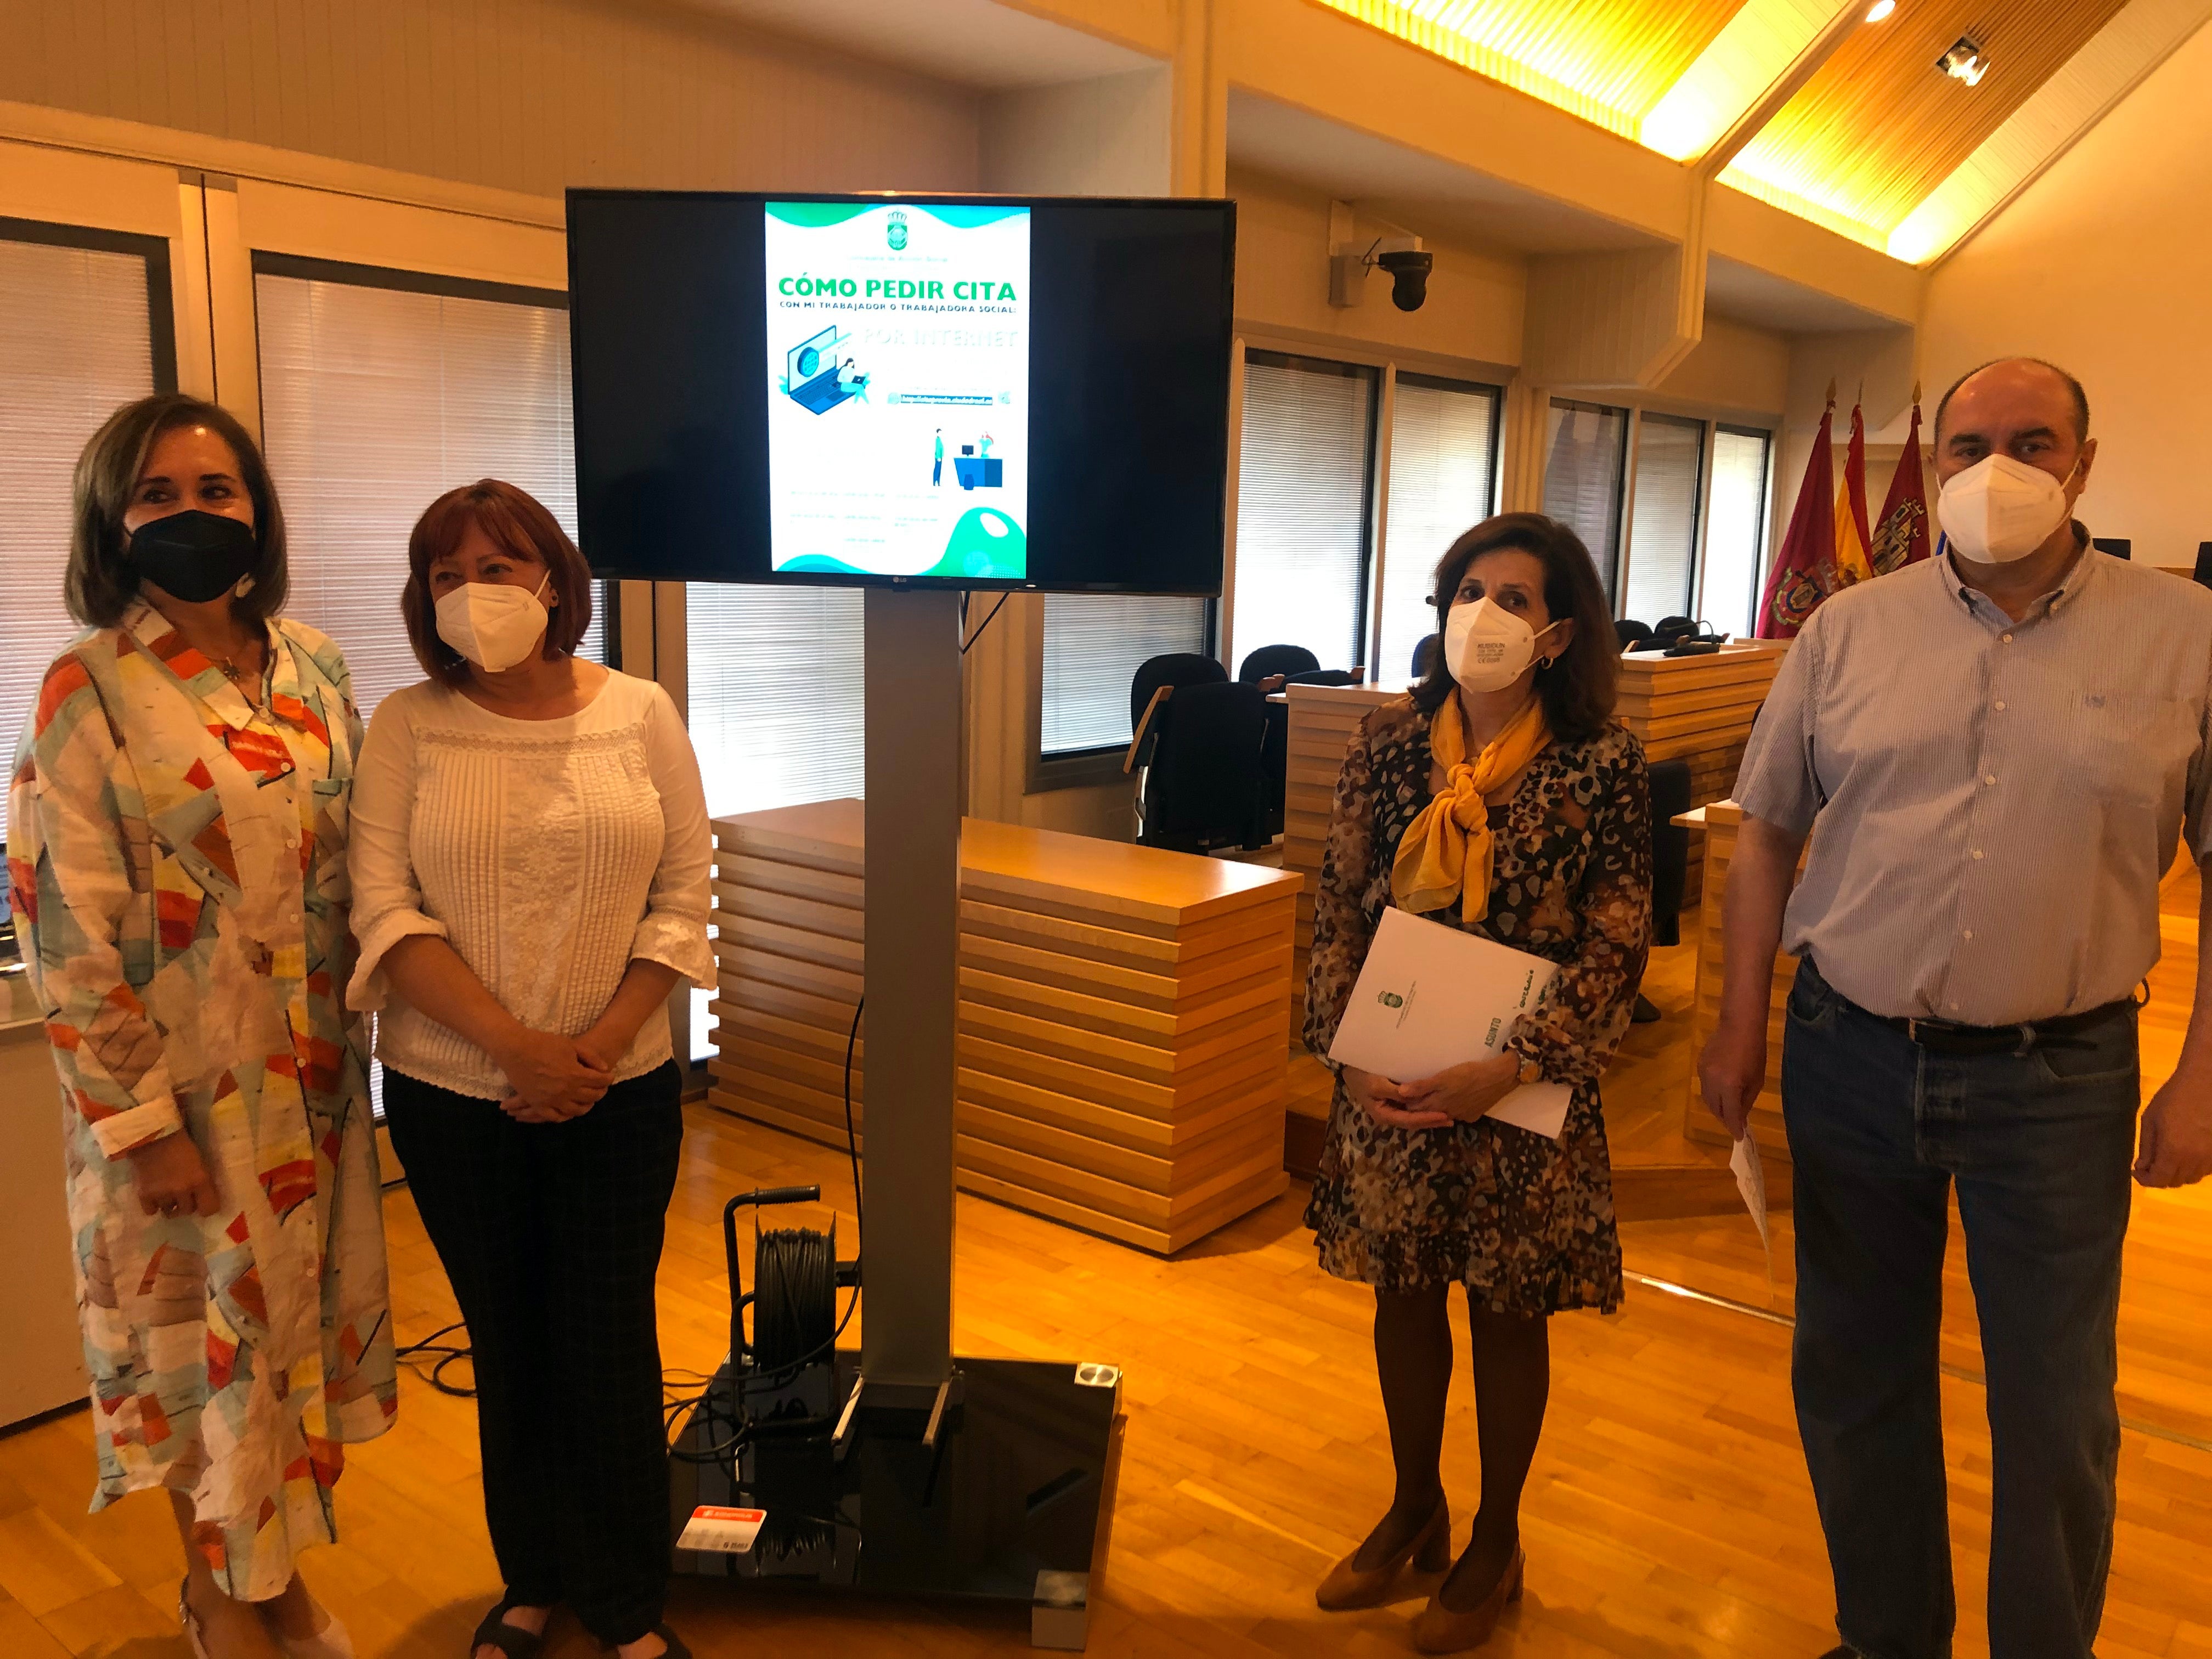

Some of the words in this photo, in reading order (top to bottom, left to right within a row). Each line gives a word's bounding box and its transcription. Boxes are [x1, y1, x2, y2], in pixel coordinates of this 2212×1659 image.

[778, 272, 857, 297] CÓMO
[866, 279, 945, 300] PEDIR
[953, 281, 1017, 301] CITA
[820, 302, 885, 311] TRABAJADOR
[900, 304, 975, 314] TRABAJADORA
[865, 329, 905, 345] POR
[915, 329, 1018, 347] INTERNET
[1484, 1017, 1502, 1048] ASUNTO
